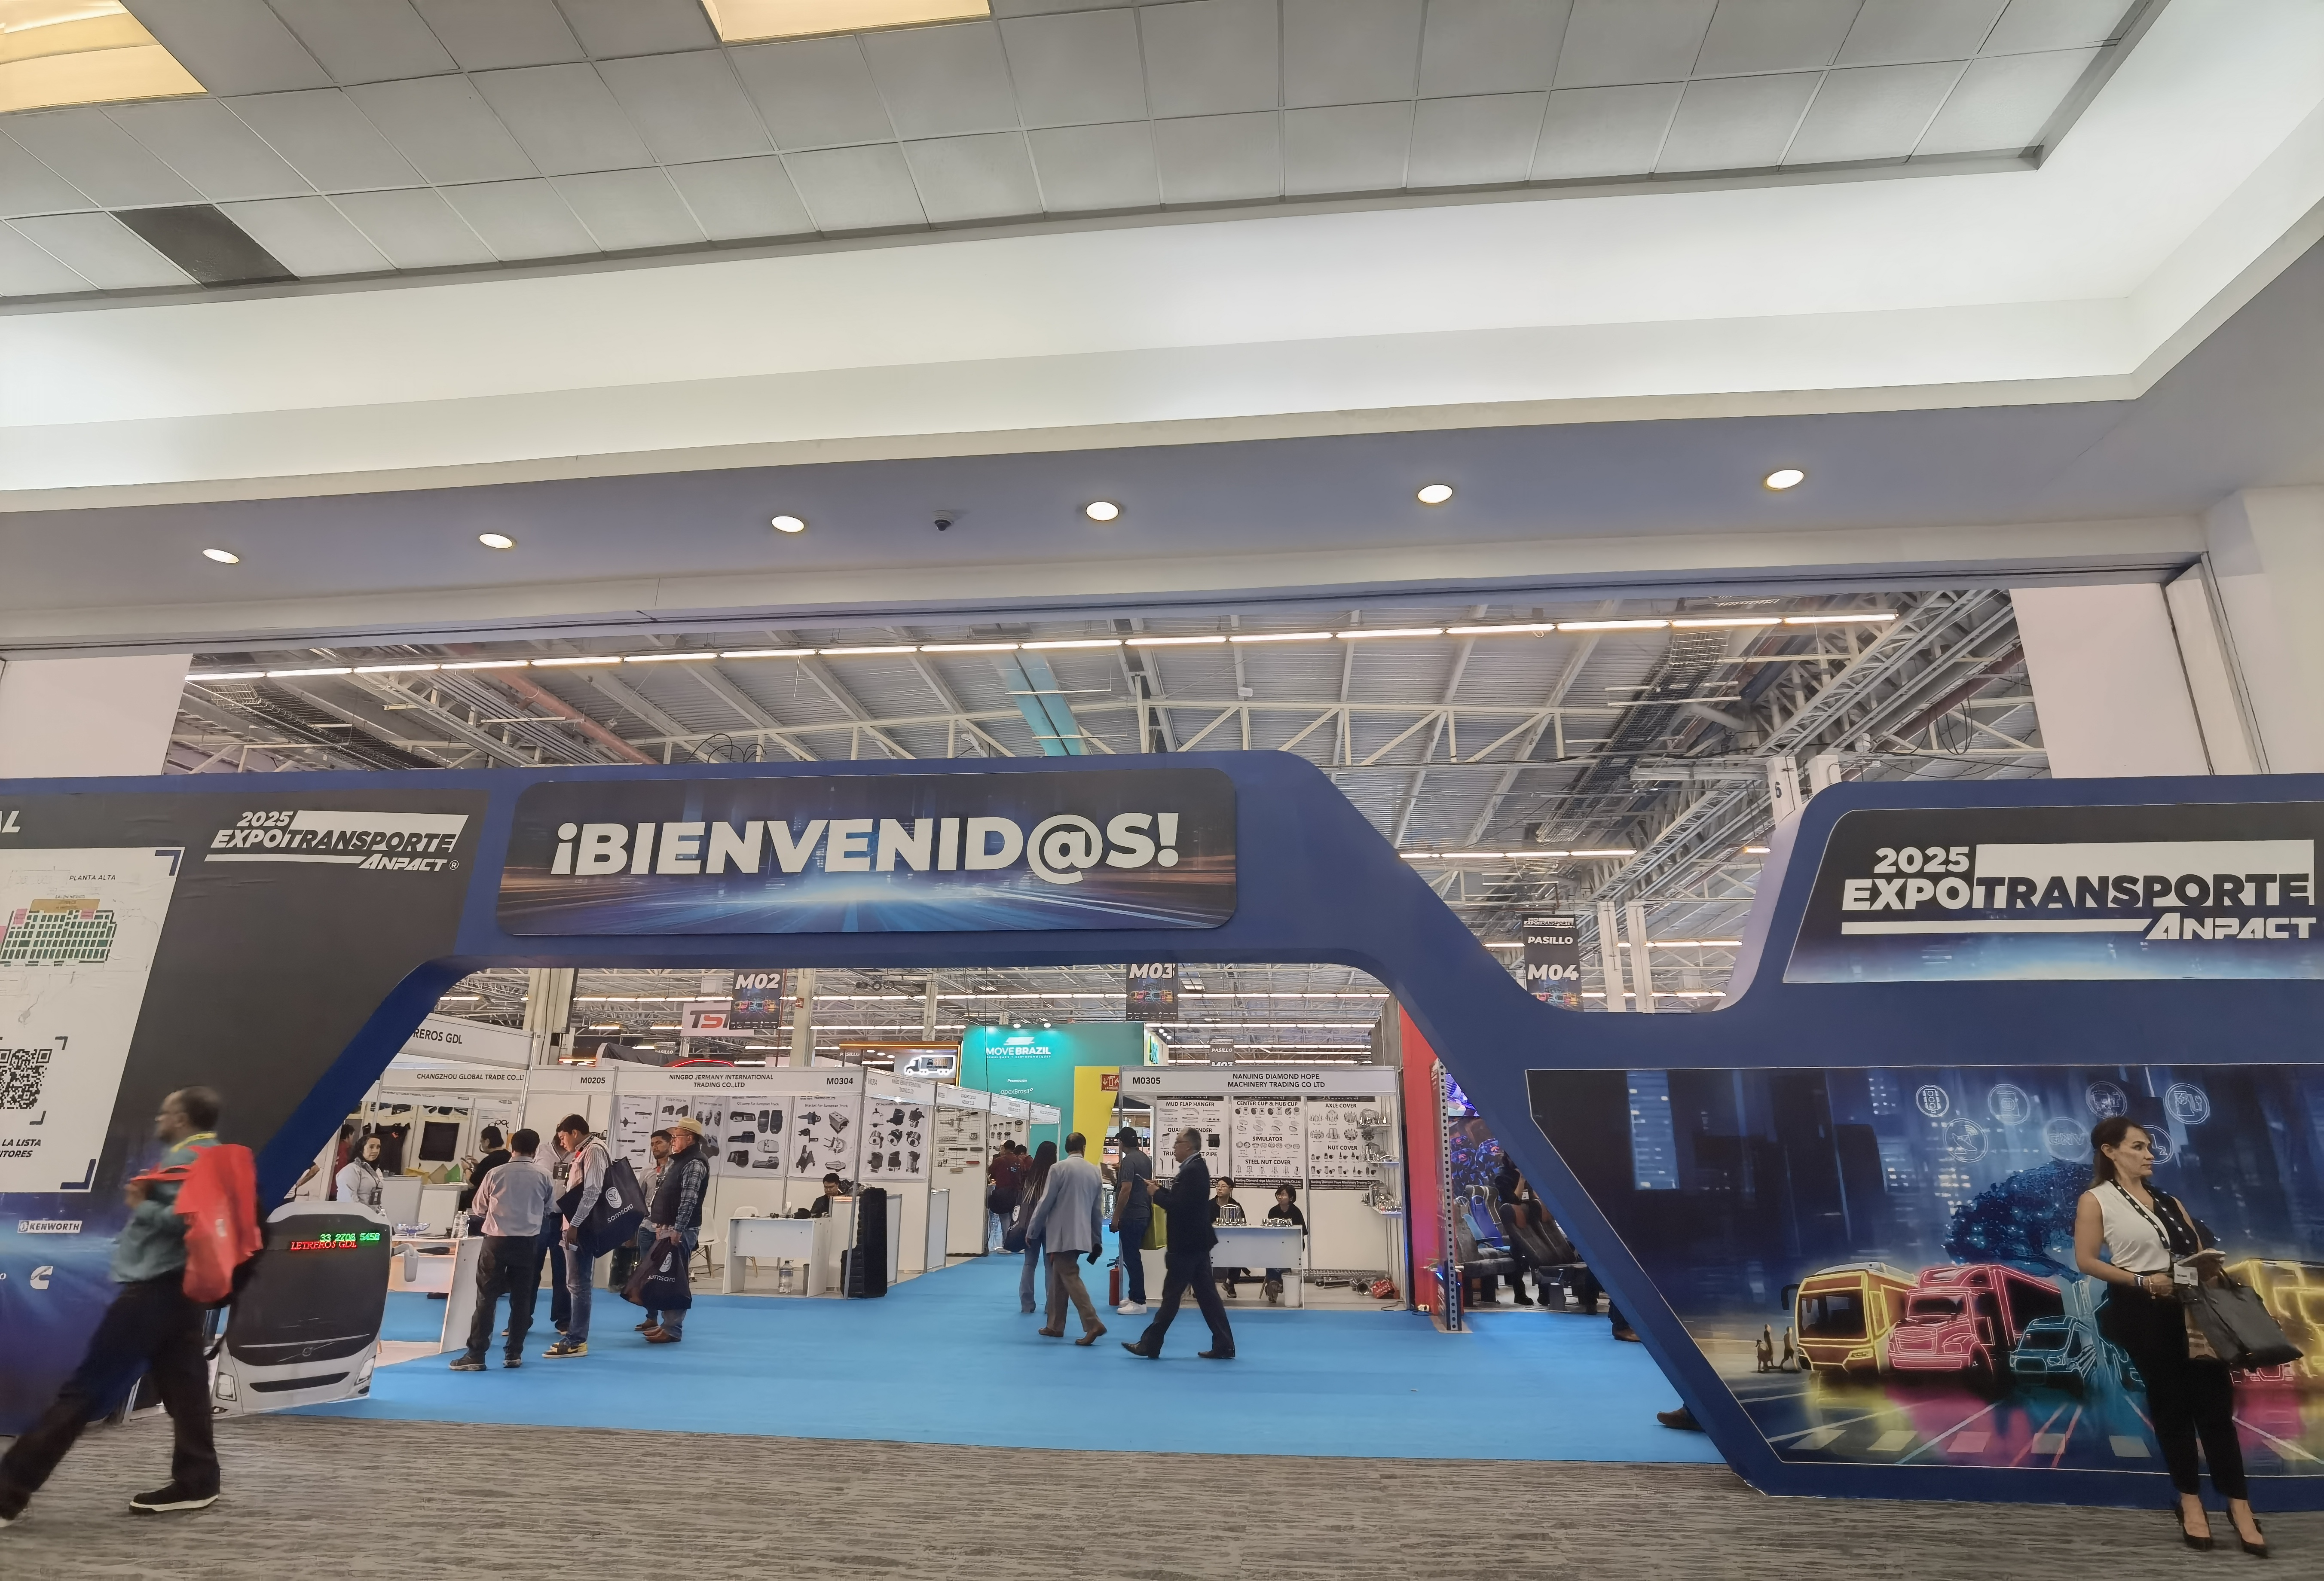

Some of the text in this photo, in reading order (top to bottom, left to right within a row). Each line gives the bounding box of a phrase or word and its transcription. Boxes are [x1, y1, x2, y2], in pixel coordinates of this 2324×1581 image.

[1775, 781, 1782, 799] 6
[236, 811, 294, 827] 2025
[210, 829, 457, 853] EXPOTRANSPORTE
[550, 812, 1180, 885] ¡BIENVENID@S!
[1874, 845, 1970, 874] 2025
[1841, 873, 2311, 912] EXPOTRANSPORTE
[2145, 912, 2317, 940] ANPACT
[1527, 936, 1574, 945] PASILLO
[1128, 963, 1176, 979] M03
[1527, 964, 1579, 981] M04
[735, 973, 780, 990] M02
[446, 1033, 462, 1044] GDL
[986, 1047, 1051, 1056] MOVE BRAZIL
[2049, 1133, 2085, 1145] GNV
[290, 1241, 336, 1250] LETREROS
[319, 1234, 332, 1242] 33
